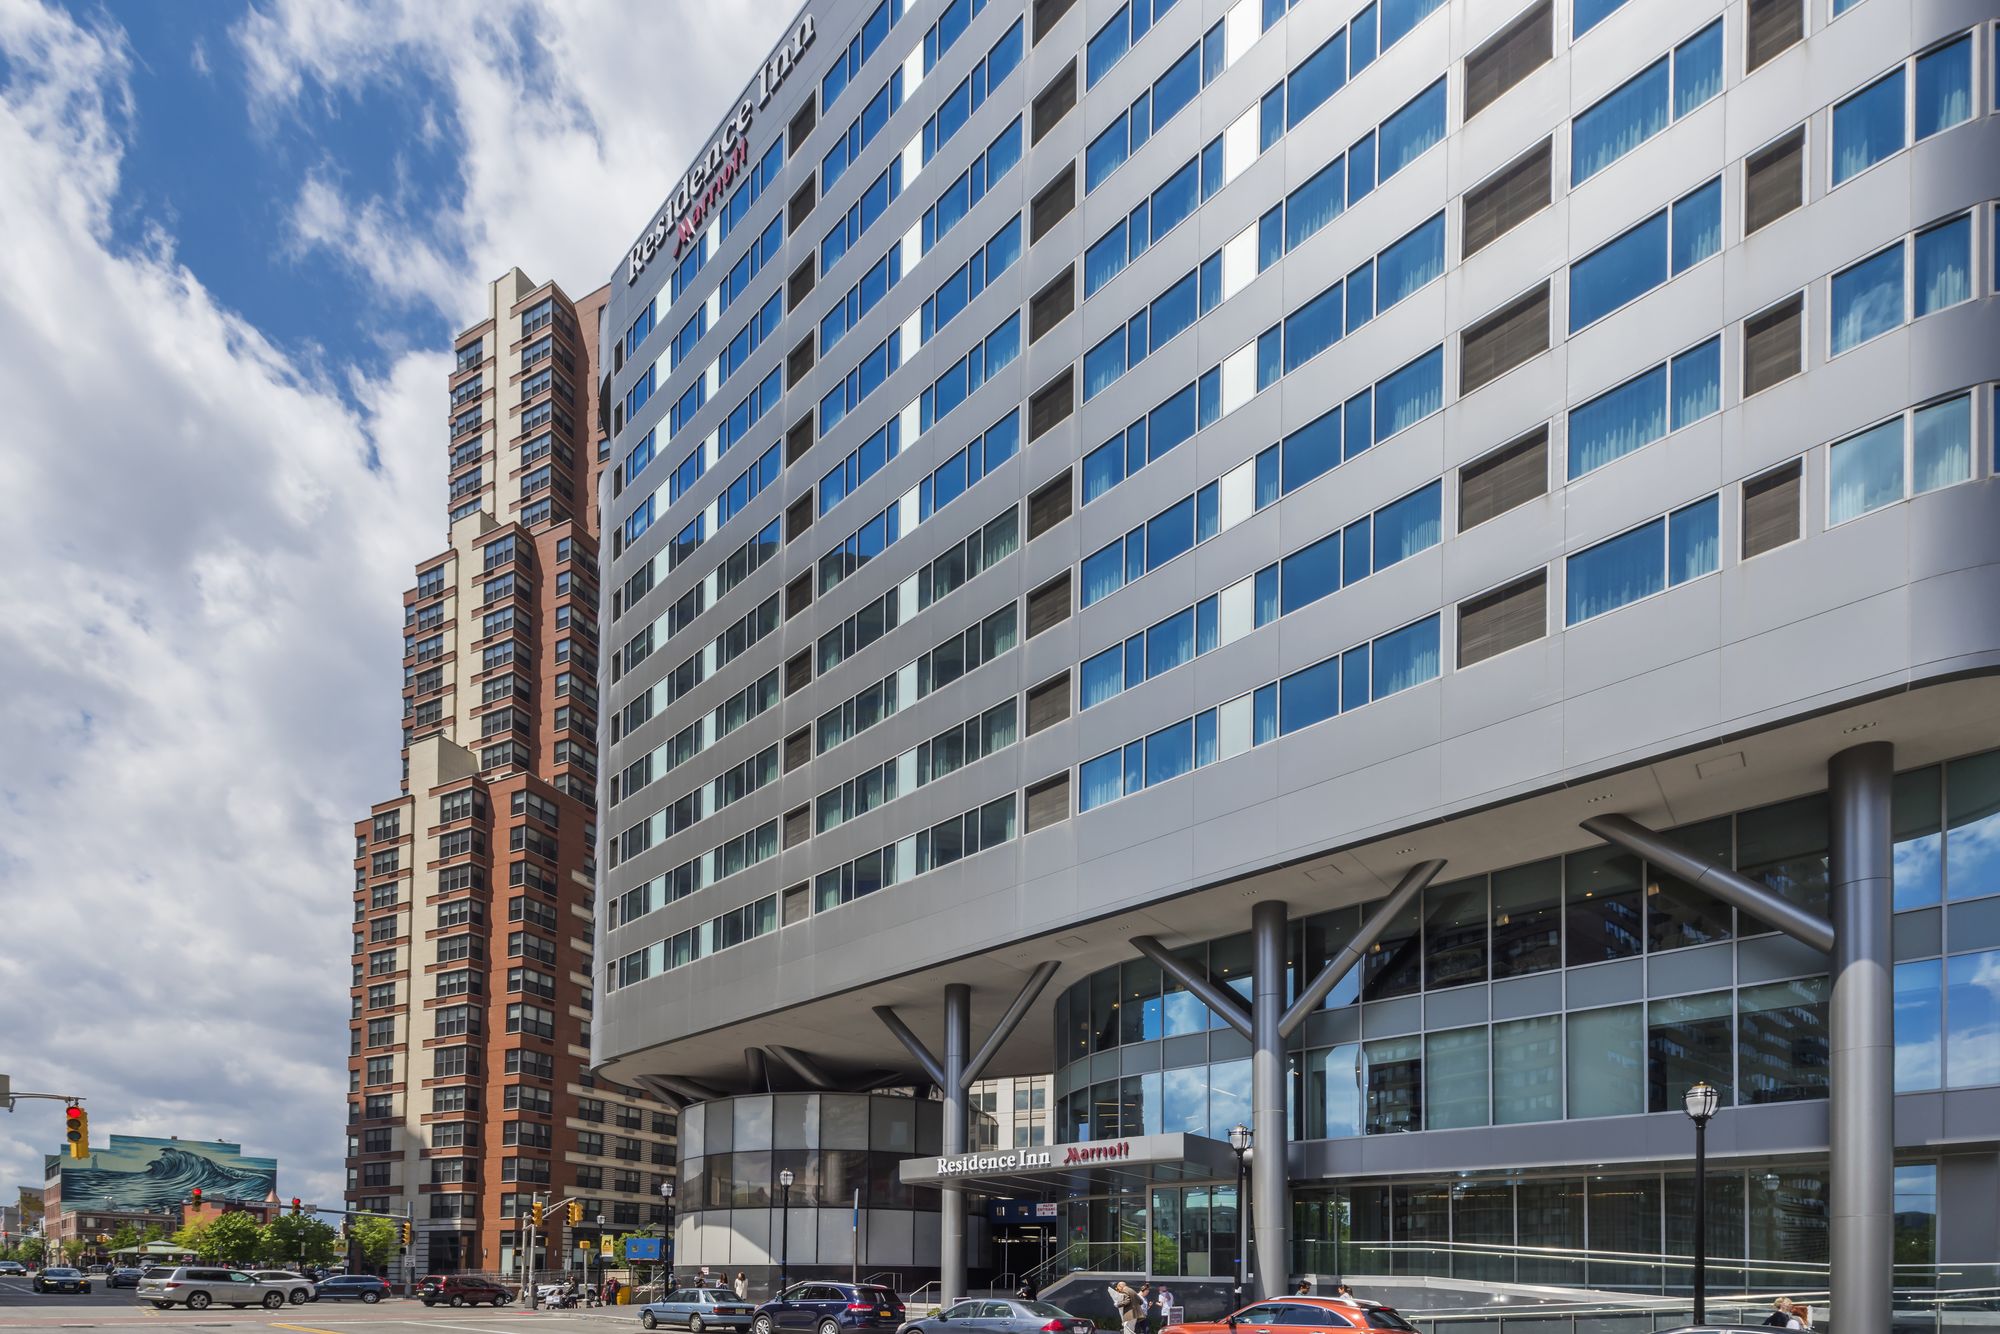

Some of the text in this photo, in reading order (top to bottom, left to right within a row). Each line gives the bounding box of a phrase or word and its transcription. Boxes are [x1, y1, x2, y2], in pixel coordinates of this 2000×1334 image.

[628, 13, 817, 284] Residence Inn
[673, 136, 748, 259] Marriott
[937, 1149, 1051, 1174] Residence Inn
[1063, 1141, 1130, 1164] Marriott
